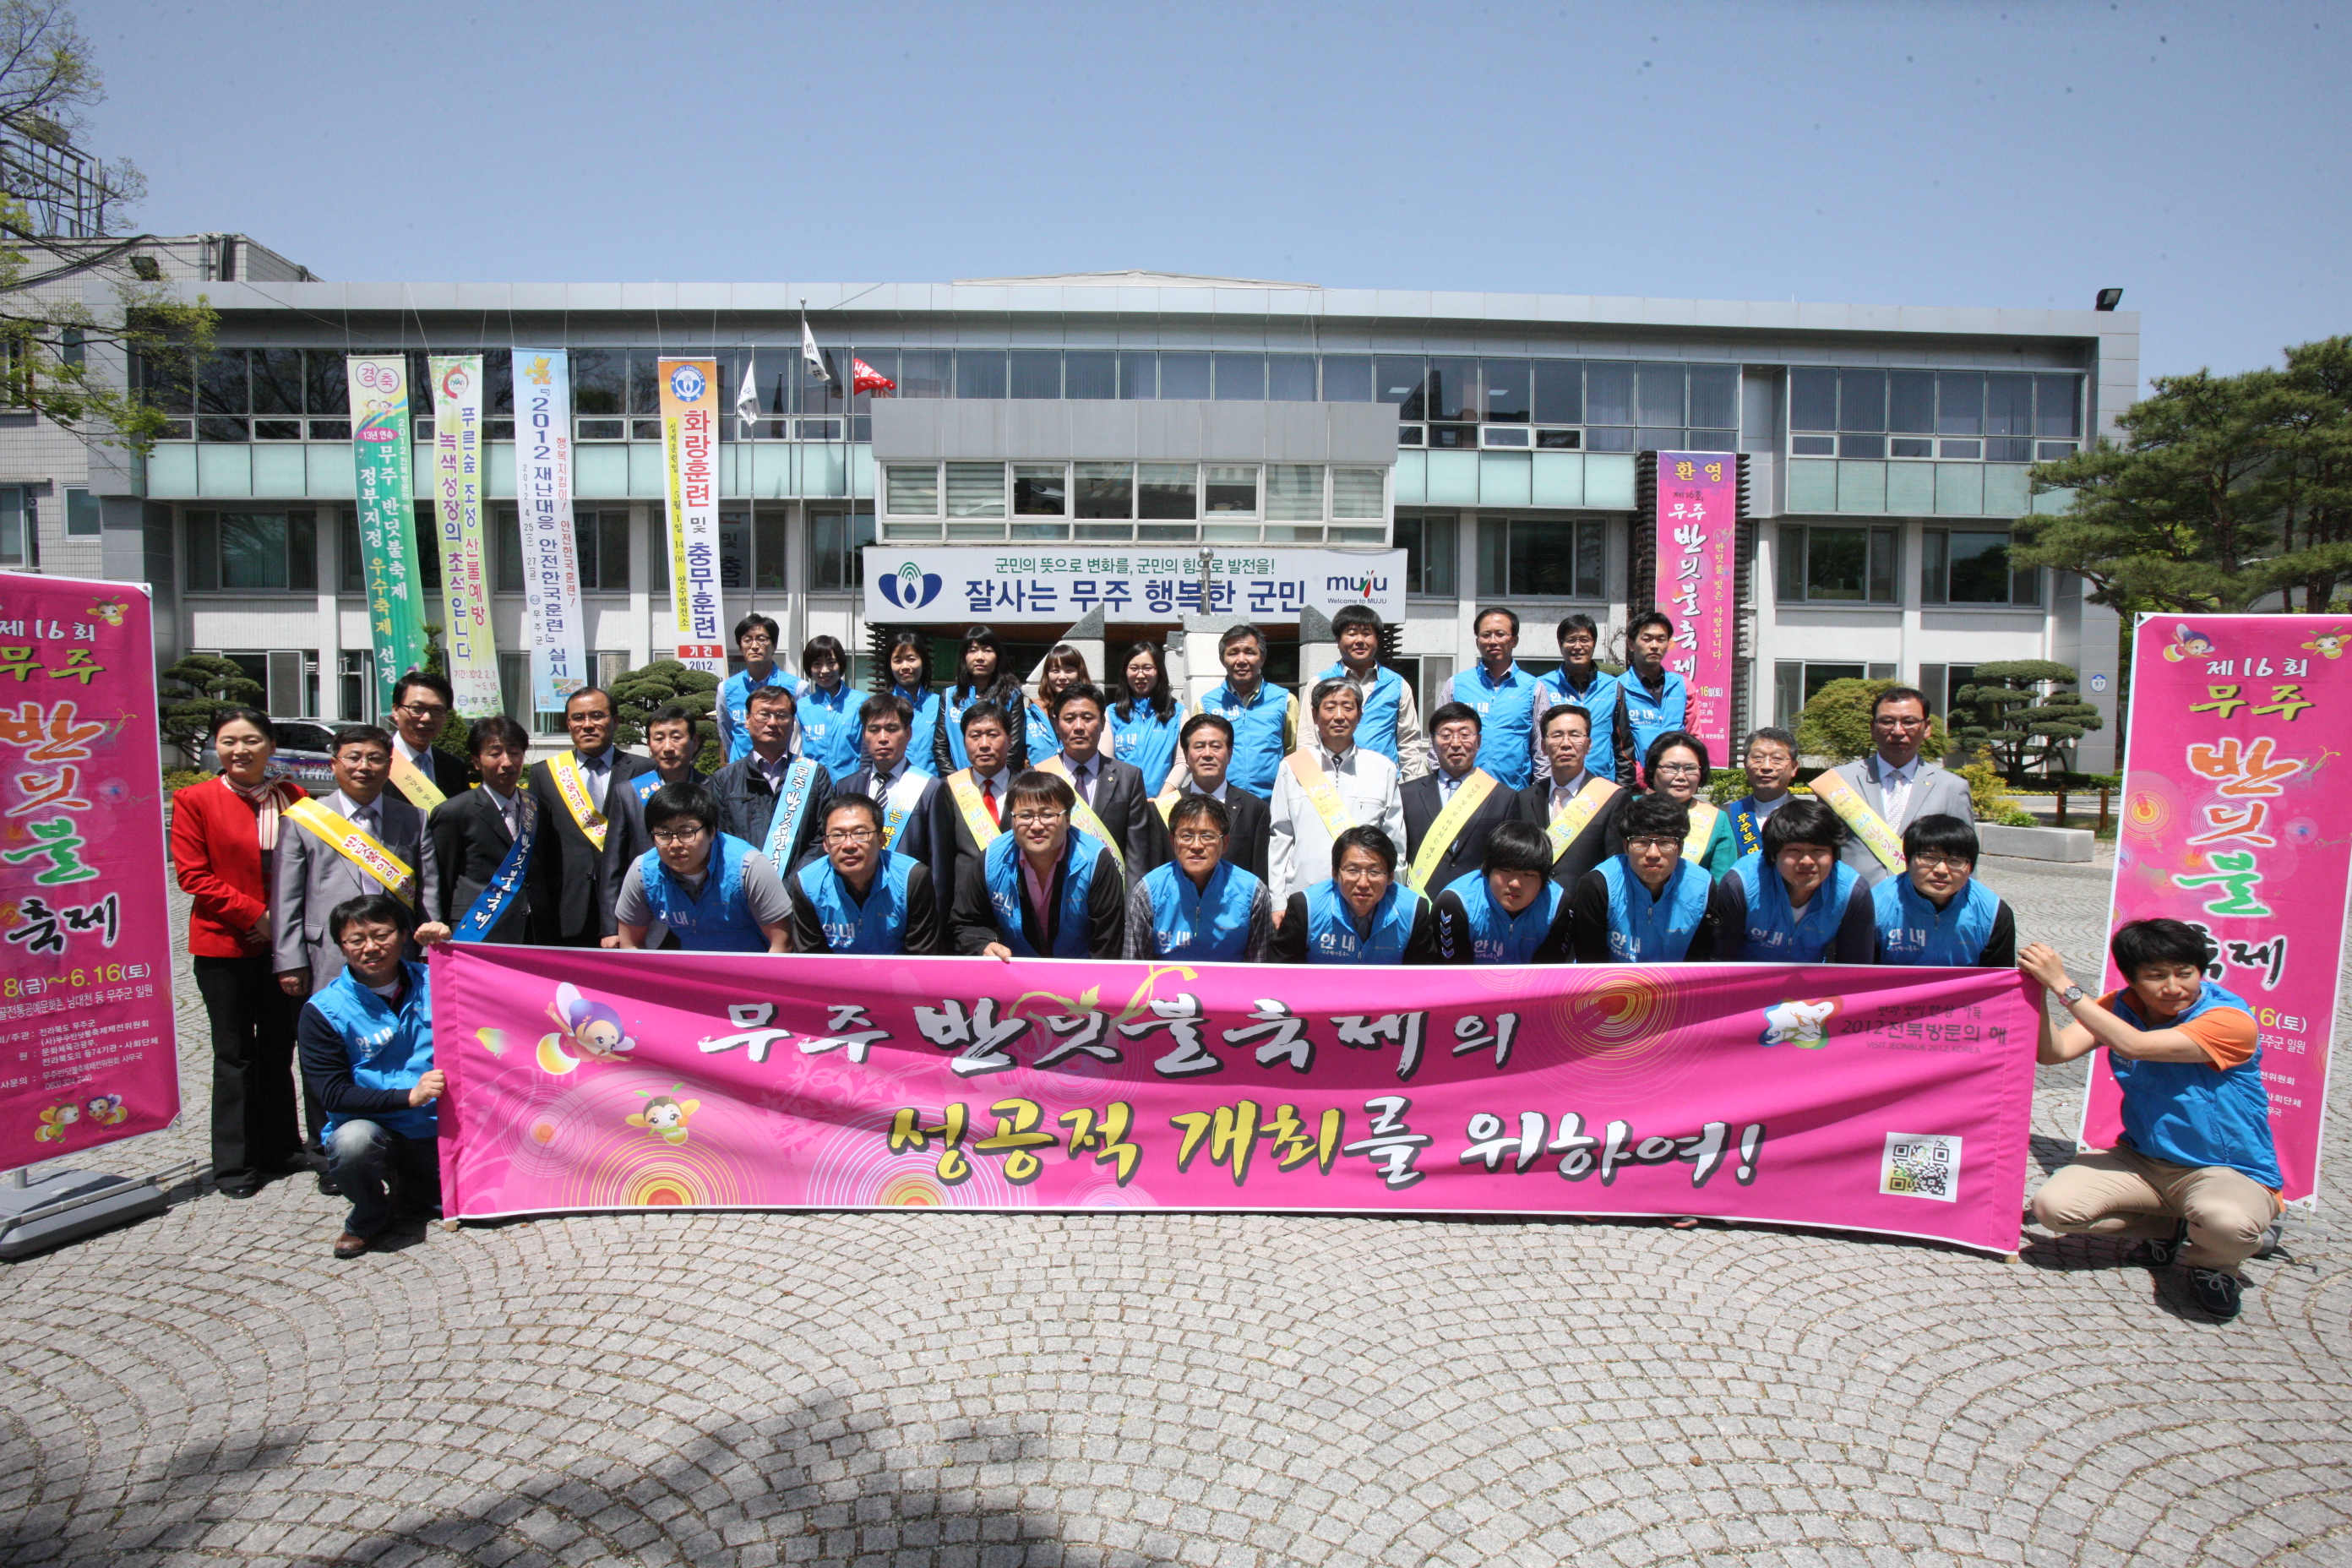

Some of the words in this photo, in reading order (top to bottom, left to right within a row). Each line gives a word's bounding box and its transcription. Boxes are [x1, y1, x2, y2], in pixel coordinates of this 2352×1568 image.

[672, 366, 685, 378] MUJU
[685, 365, 705, 380] COUNTY
[362, 431, 378, 440] 13년
[379, 430, 395, 440] 연속
[461, 407, 476, 474] 푸른숲
[378, 445, 398, 486] 무주
[683, 410, 711, 507] 화랑훈련
[1674, 461, 1722, 482] 환영
[439, 431, 462, 542] 녹색성장의
[557, 437, 569, 512] 행복지킴이!
[360, 466, 383, 548] 정부지정
[464, 484, 476, 528] 조성
[1674, 491, 1704, 502] 제16회
[690, 516, 706, 534] 및
[1668, 503, 1707, 521] 무주
[381, 497, 408, 602] 반딧불축제
[560, 520, 576, 607] 안전한국훈련!
[1713, 542, 1725, 574] 반딧불
[465, 537, 486, 626] 산불예방
[534, 466, 555, 531] 재난대응
[548, 648, 568, 678] 실시
[994, 558, 1036, 574] 군민의
[1040, 558, 1083, 574] 뜻으로
[1087, 558, 1133, 576] 변화를,
[1136, 558, 1178, 574] 군민의
[1228, 558, 1275, 574] 발전을!
[368, 557, 392, 636] 우수축제
[677, 575, 689, 627] 양수발전소
[687, 542, 716, 640] 충무훈련
[965, 579, 1058, 612] 잘사는
[1070, 580, 1132, 612] 무주
[1145, 580, 1236, 613] 행복한
[1248, 580, 1305, 612] 군민
[447, 552, 472, 662] 초석입니다
[0, 618, 95, 642] 제16회
[533, 609, 542, 645] 무주군
[0, 645, 107, 685] 무주
[378, 645, 397, 684] 선정
[689, 645, 713, 657] 기간
[689, 661, 716, 671] 2012.
[2206, 657, 2308, 678] 제16회
[1549, 692, 1576, 703] 안내
[2188, 684, 2317, 722] 무주
[1628, 709, 1655, 721] 안내
[1115, 733, 1137, 747] 안내
[558, 765, 585, 810] 반딧불이의
[792, 765, 810, 791] 무주
[1737, 812, 1757, 844] 무주로
[343, 834, 400, 880] 반딧불이의
[6, 893, 120, 953] 축제
[822, 922, 856, 939] 안내
[1887, 928, 1926, 947] 안내
[1157, 930, 1190, 947] 안내
[1320, 933, 1356, 952] 안내
[1473, 939, 1504, 958] 안내
[1610, 930, 1642, 953] 안내
[67, 993, 93, 1009] 남대천
[95, 991, 104, 1005] 등
[106, 987, 133, 1002] 무주군
[135, 983, 154, 999] 일원
[39, 1024, 70, 1037] 전라북도
[73, 1019, 95, 1031] 무주군
[355, 1026, 395, 1053] 안내
[698, 1001, 893, 1064] 무주
[1989, 1025, 2007, 1045] 해
[1866, 1041, 1886, 1050] VISIT
[1887, 1043, 1926, 1052] JEONBUK
[1952, 1045, 1981, 1054] KOREA
[2287, 1038, 2306, 1054] 일원
[886, 1097, 1142, 1185] 성공적
[1170, 1095, 1433, 1191] 개최를
[1458, 1111, 1767, 1189] 위하여!
